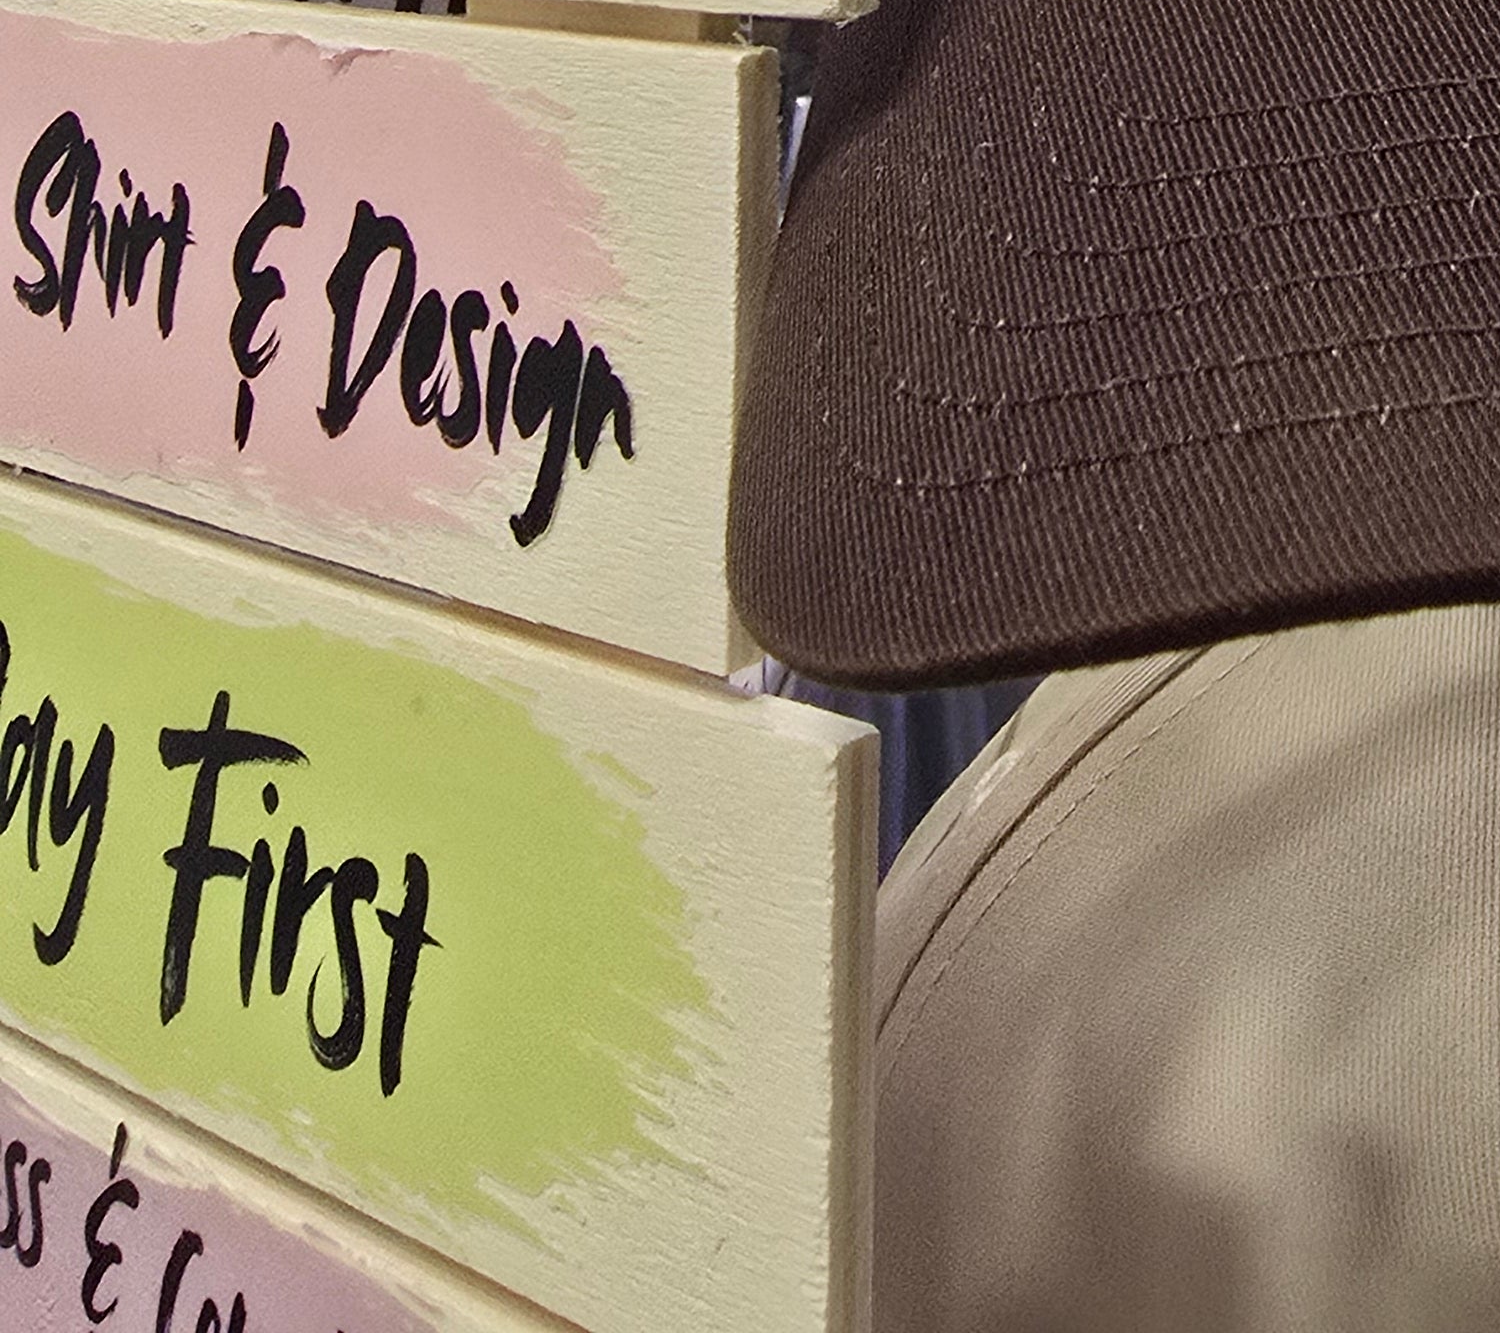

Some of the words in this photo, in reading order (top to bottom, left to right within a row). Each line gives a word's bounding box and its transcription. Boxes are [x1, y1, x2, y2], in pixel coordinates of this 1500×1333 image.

[13, 110, 197, 341] Shirt
[229, 121, 306, 453] &
[316, 199, 636, 549] Design
[0, 620, 115, 967] ay
[158, 690, 444, 1098] First
[81, 1122, 140, 1325] &
